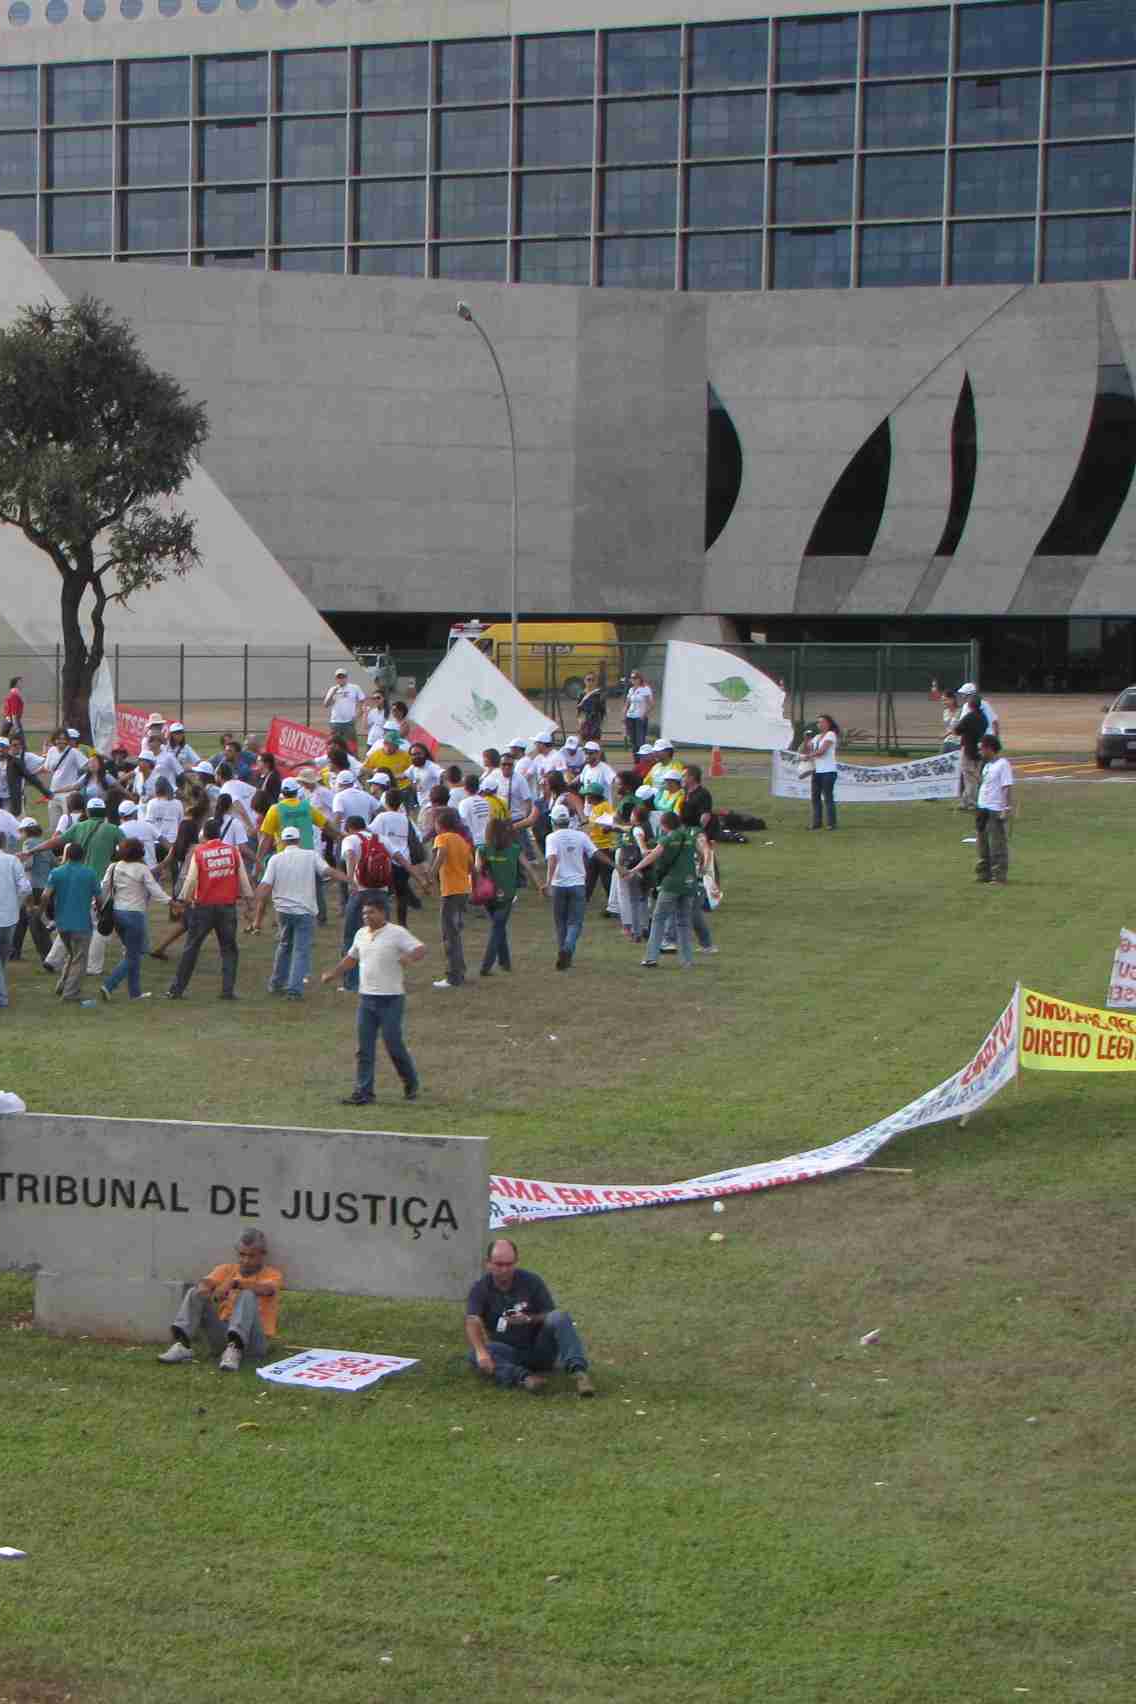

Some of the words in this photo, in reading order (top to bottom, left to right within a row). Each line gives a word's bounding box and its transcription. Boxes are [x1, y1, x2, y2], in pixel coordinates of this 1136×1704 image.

[1022, 1026, 1091, 1059] DIREITO
[210, 1184, 261, 1218] DE
[280, 1190, 460, 1240] JUSTIÇA
